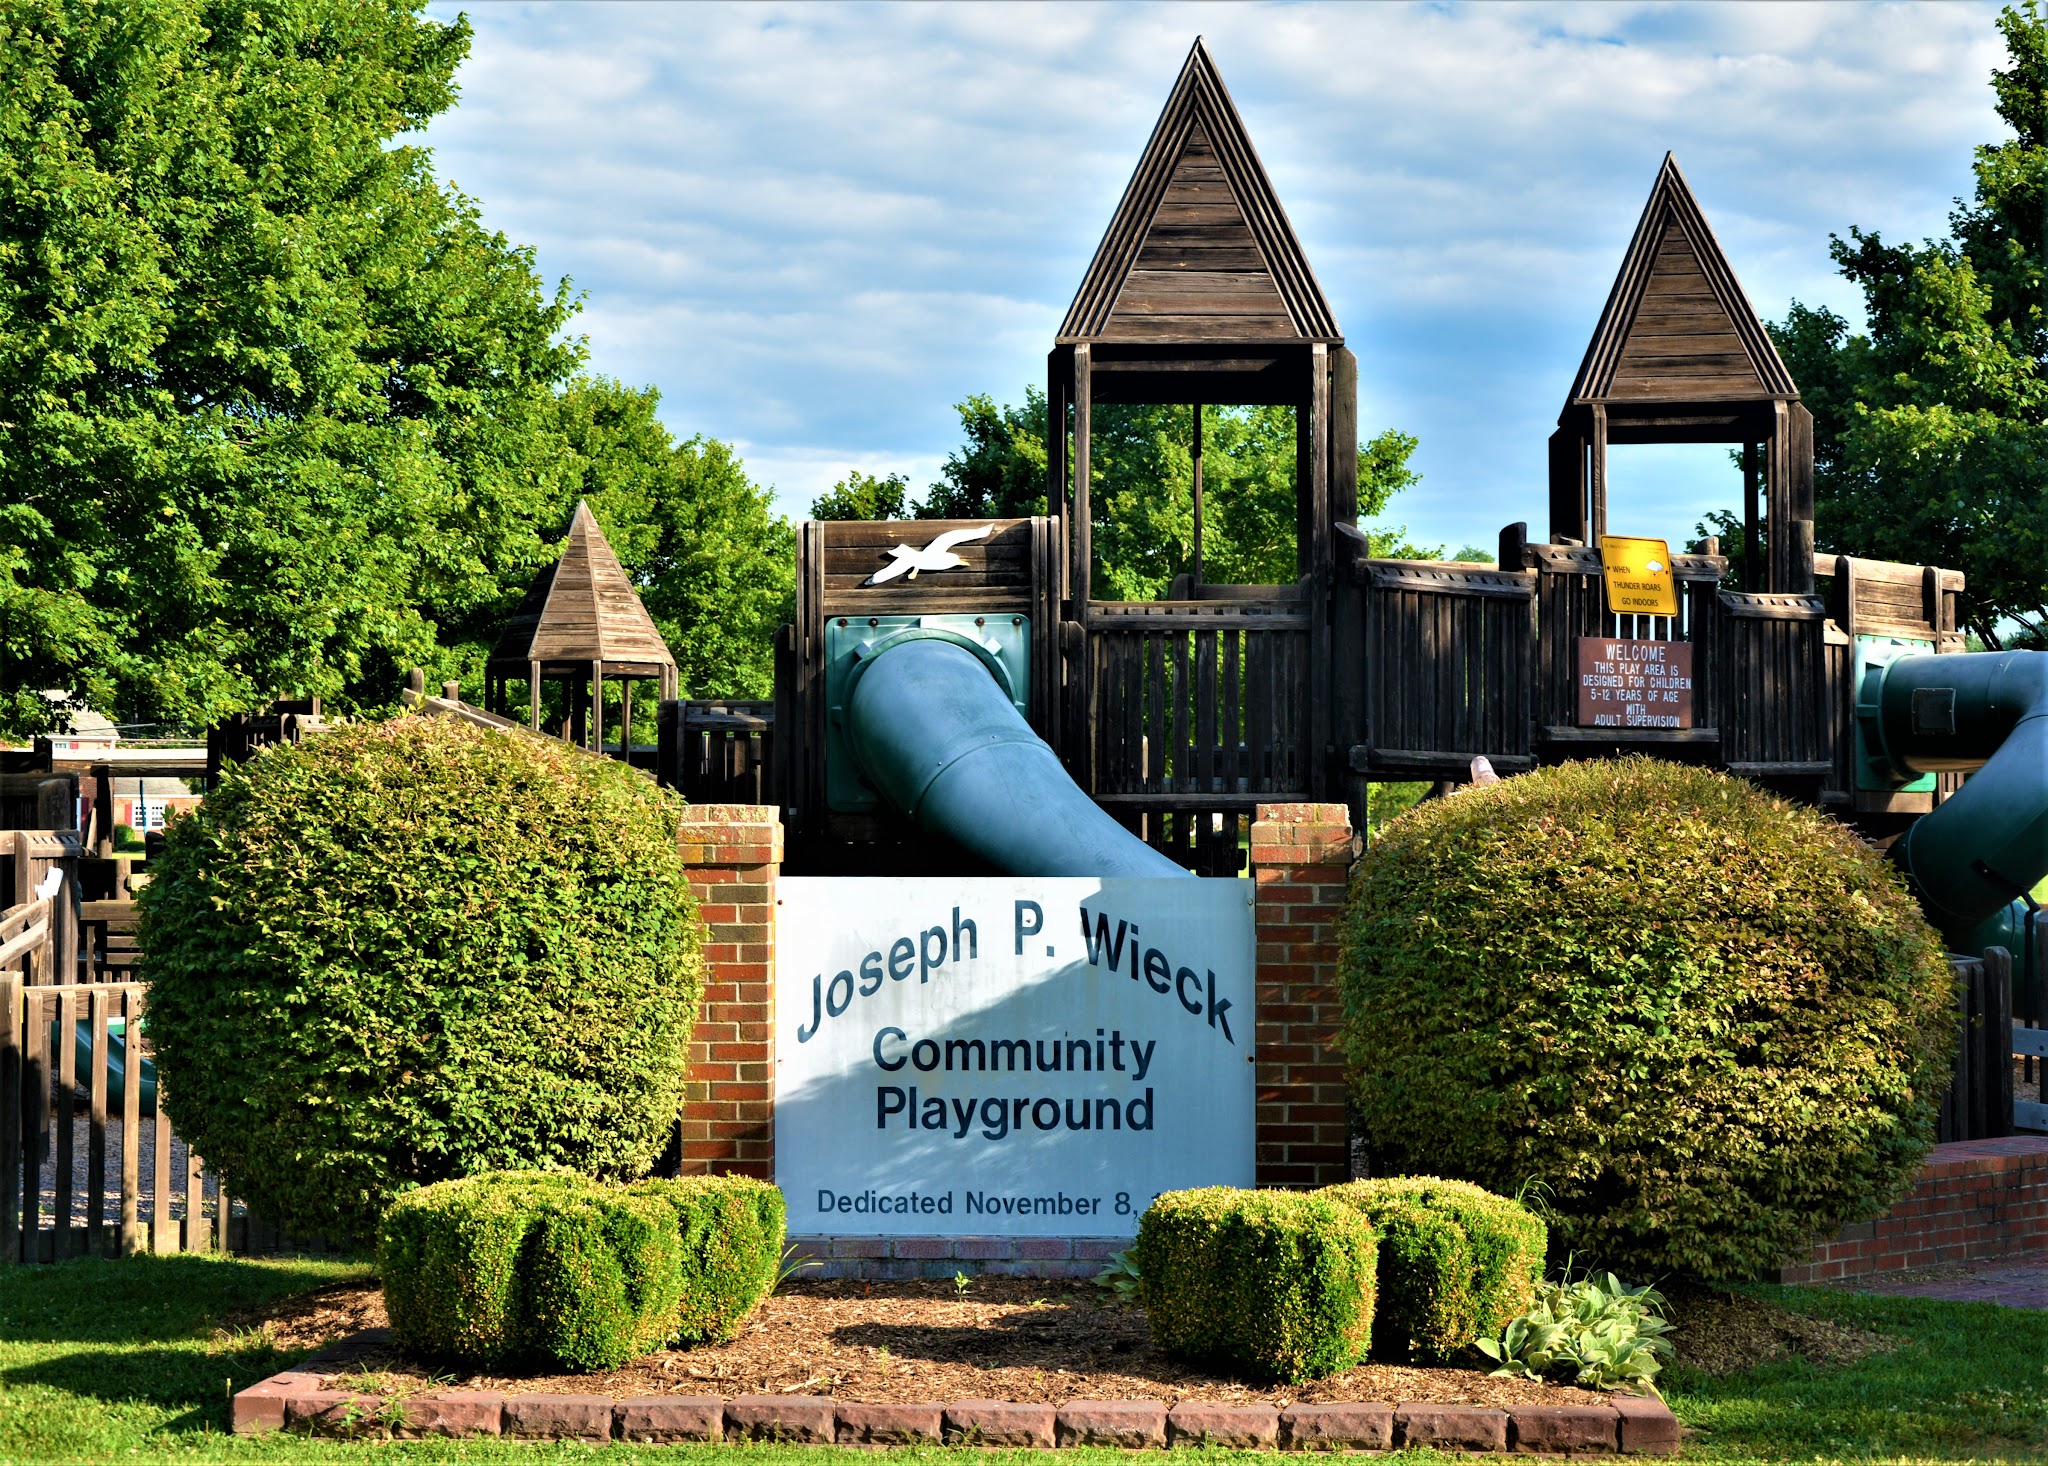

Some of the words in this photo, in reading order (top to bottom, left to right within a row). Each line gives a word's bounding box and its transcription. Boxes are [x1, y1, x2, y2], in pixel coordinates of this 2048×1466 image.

[1613, 581, 1640, 590] THUNDER
[1642, 583, 1661, 591] ROARS
[1622, 597, 1631, 605] GO
[1633, 598, 1659, 606] INDOORS
[1606, 644, 1666, 662] WELCOME
[1594, 662, 1615, 674] THIS
[1620, 663, 1640, 675] PLAY
[1644, 664, 1666, 676] AREA
[1670, 665, 1679, 676] IS
[1583, 674, 1623, 687] DESIGNED
[1628, 676, 1645, 688] FOR
[1650, 677, 1691, 689] CHILDREN
[1591, 689, 1610, 700] 5-12
[1615, 689, 1642, 701] YEARS
[1648, 690, 1658, 701] OF
[1663, 691, 1679, 703] AGE
[1626, 704, 1646, 715] WITH
[1594, 714, 1621, 726] ADULT
[1626, 715, 1680, 727] SUPERVISION
[797, 906, 978, 1043] Joseph
[1014, 900, 1056, 957] P.
[1079, 907, 1235, 1045] Wieck
[873, 1027, 1156, 1081] Community
[878, 1086, 1154, 1140] Playground
[818, 1190, 953, 1215] Dedicated
[966, 1191, 1101, 1216] November
[1114, 1191, 1138, 1220] 8,
